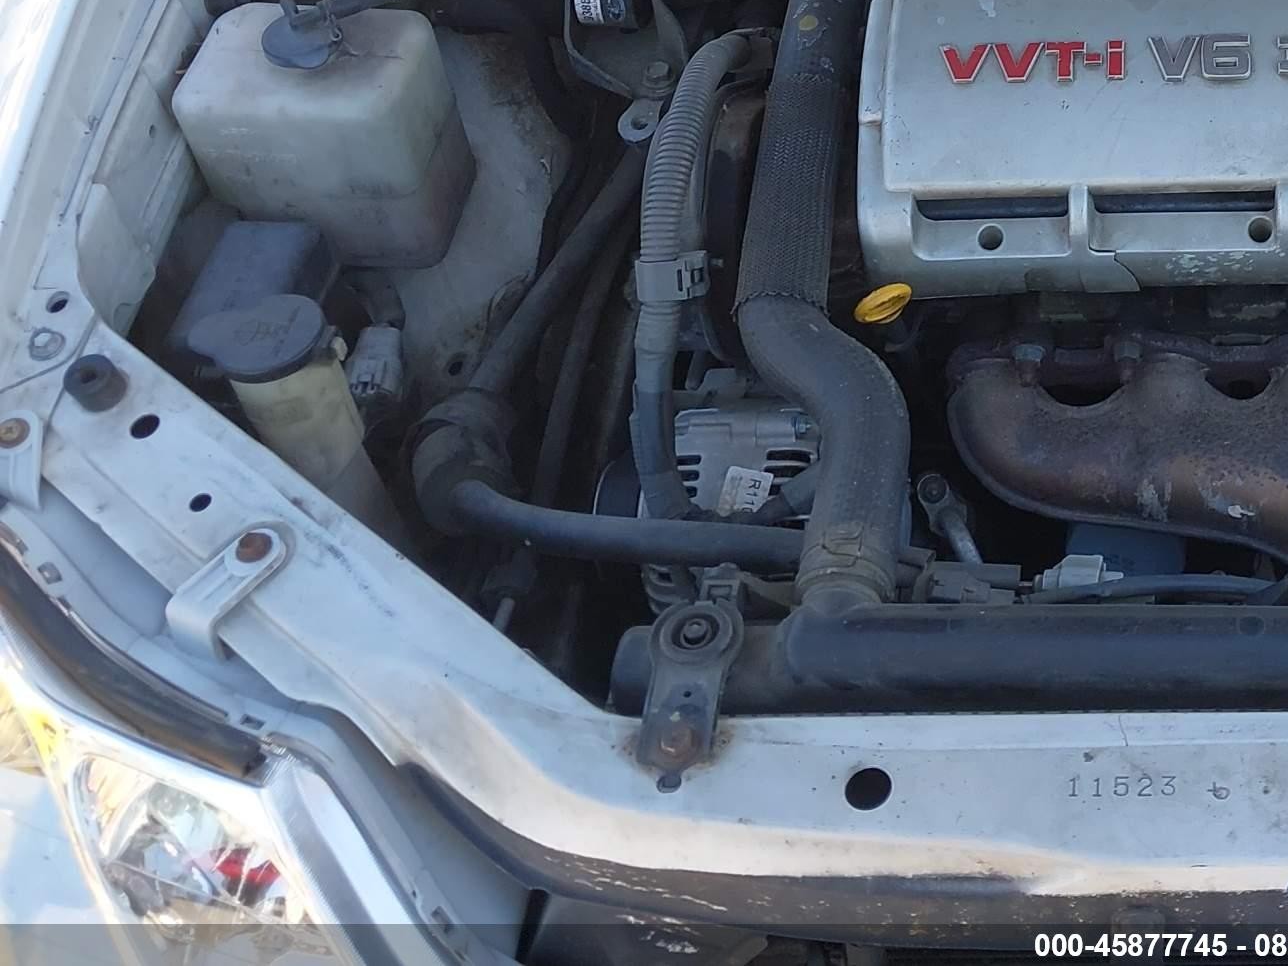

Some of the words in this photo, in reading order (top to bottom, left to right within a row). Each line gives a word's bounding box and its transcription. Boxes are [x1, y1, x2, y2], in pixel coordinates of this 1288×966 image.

[939, 39, 1126, 83] VVT-i
[1147, 33, 1252, 82] V6
[1067, 775, 1177, 798] 11523
